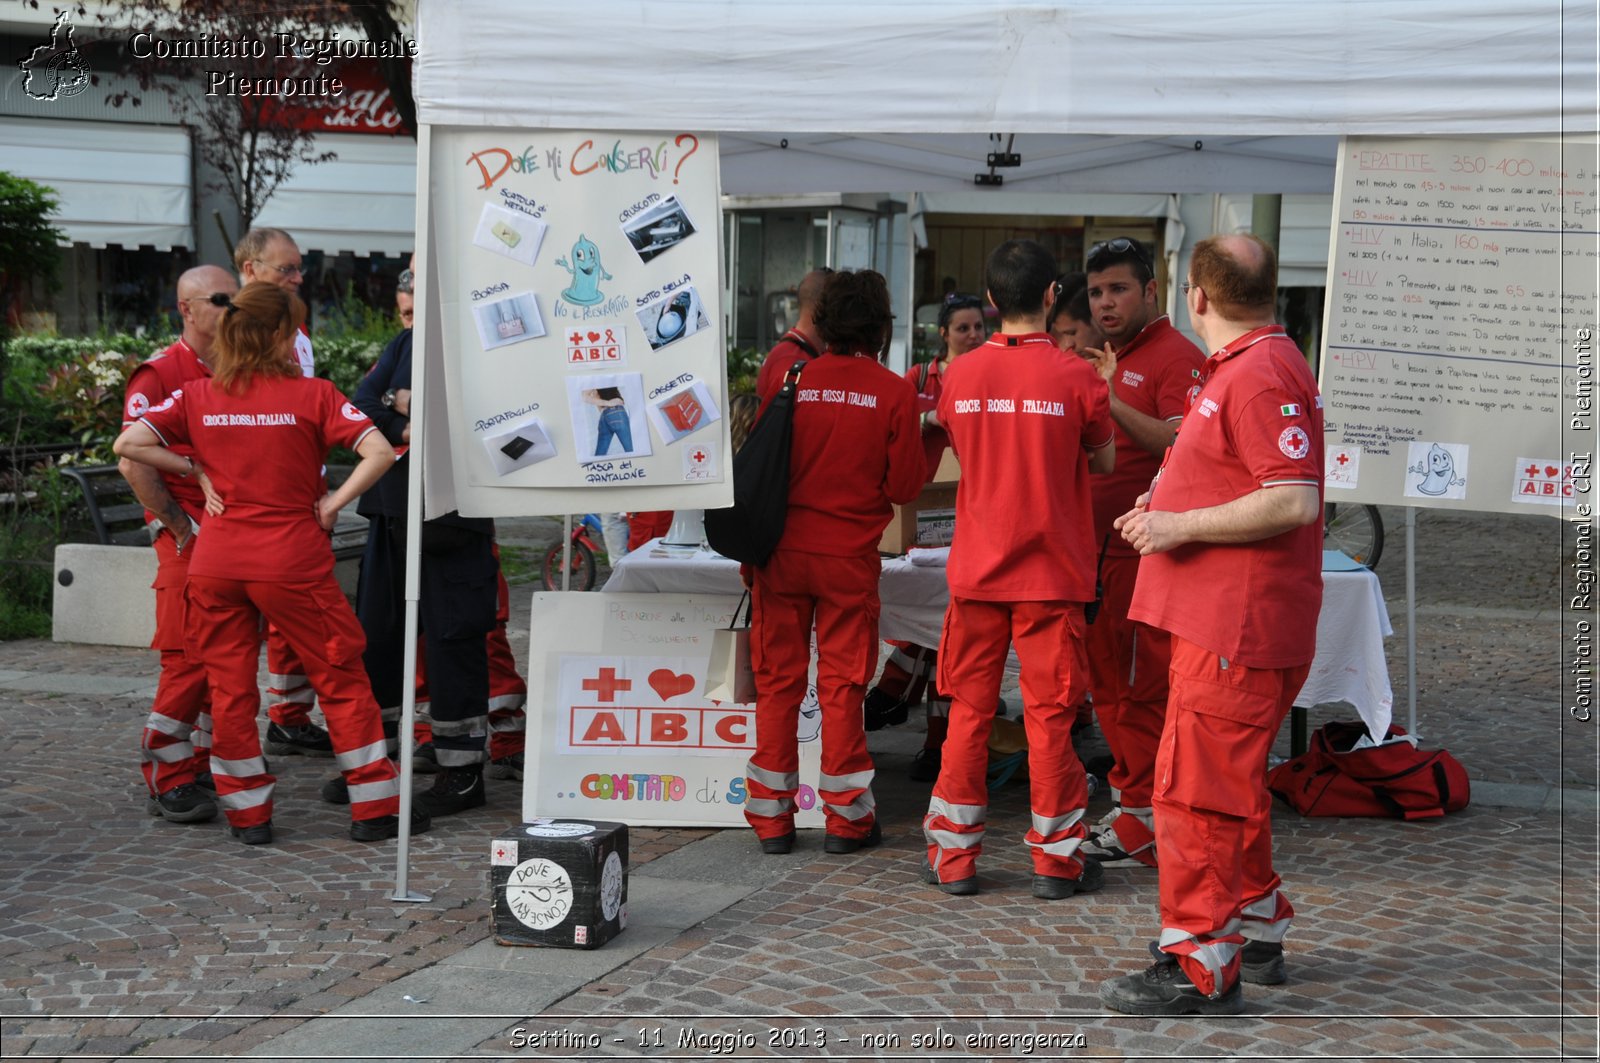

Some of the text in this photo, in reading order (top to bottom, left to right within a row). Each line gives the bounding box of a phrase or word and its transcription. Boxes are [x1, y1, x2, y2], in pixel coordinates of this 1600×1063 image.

[1360, 151, 1430, 170] EPATITE
[1450, 155, 1535, 178] 350-400
[1374, 179, 1398, 189] mondo
[1403, 182, 1416, 190] con
[618, 192, 661, 224] CRUSCOTTO
[1352, 227, 1384, 243] HIV
[1455, 234, 1479, 250] 160
[1505, 246, 1530, 255] persone
[1348, 269, 1378, 285] HIV
[636, 273, 692, 307] SOTTO SELLA
[1341, 351, 1377, 369] HPV
[648, 372, 694, 401] CASSETTO
[798, 388, 877, 409] CROCE ROSSA ITALIANA
[954, 398, 1065, 417] CROCE ROSSA ITALIANA
[203, 413, 297, 427] CROCE ROSSA ITALIANA
[620, 460, 633, 470] del
[585, 467, 647, 484] PANTALONE
[671, 611, 686, 623] alle
[696, 777, 721, 804] di
[515, 862, 551, 883] DOVE
[552, 876, 568, 895] MI
[511, 896, 567, 926] CONSERVI
